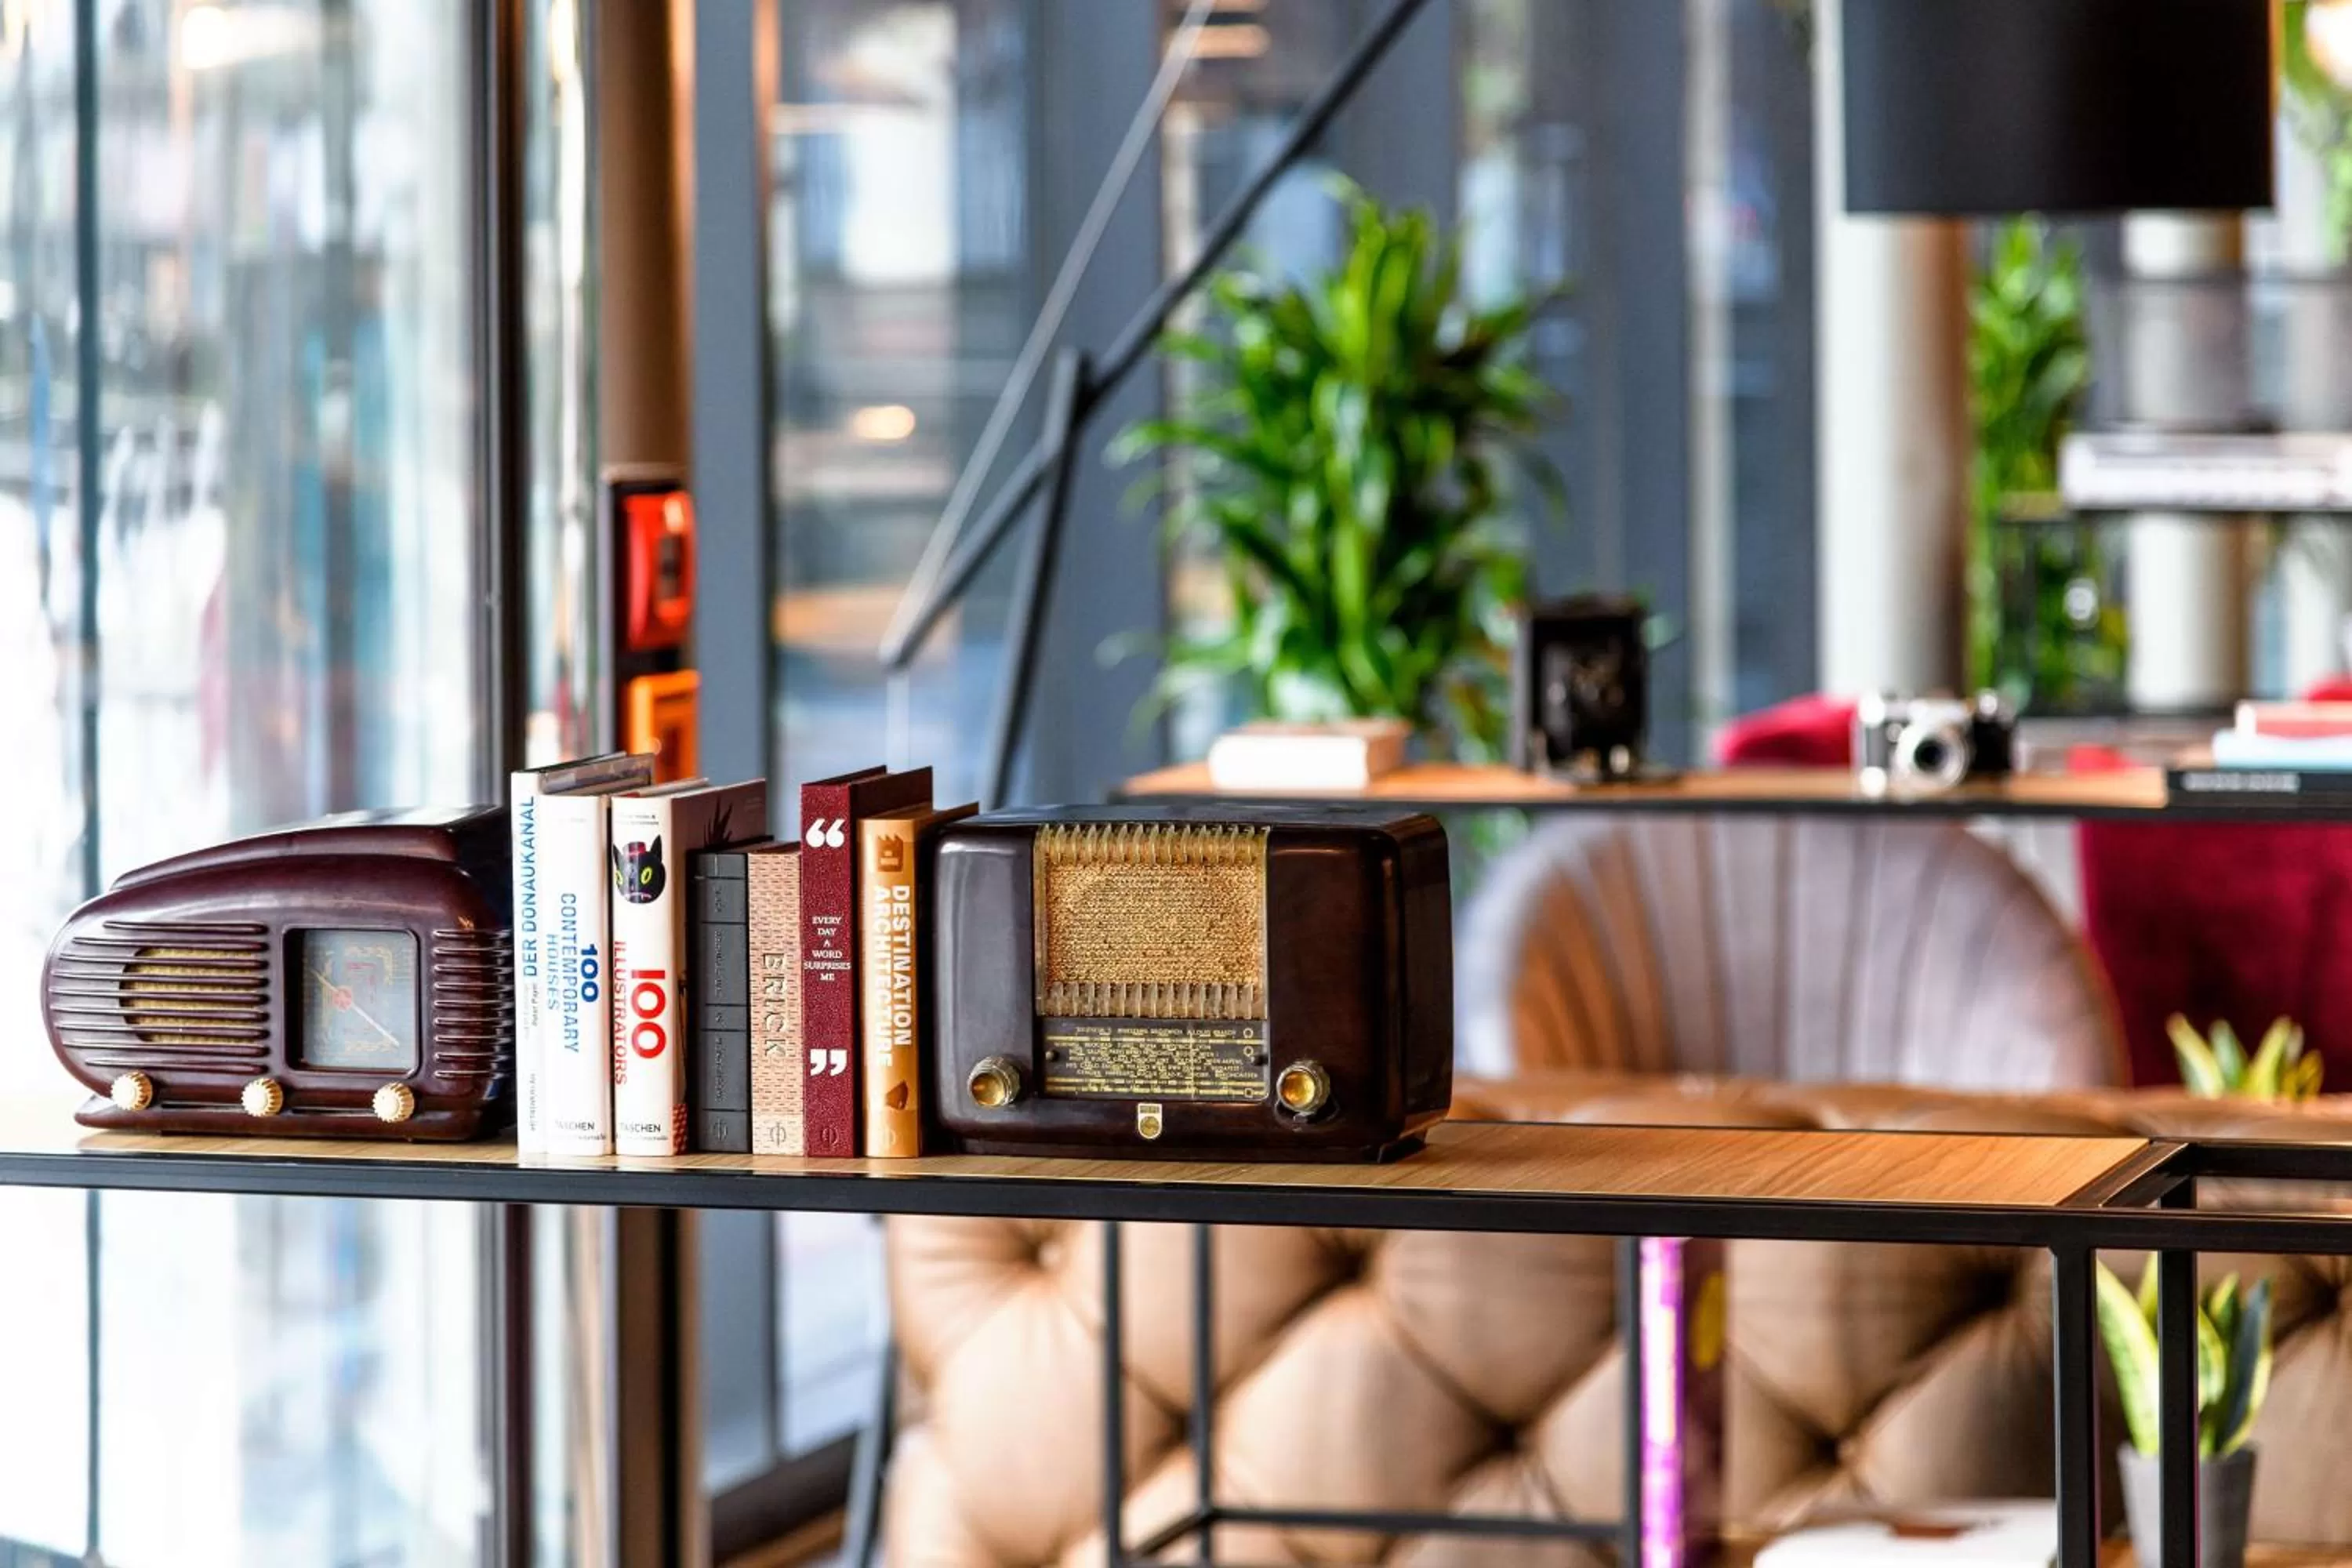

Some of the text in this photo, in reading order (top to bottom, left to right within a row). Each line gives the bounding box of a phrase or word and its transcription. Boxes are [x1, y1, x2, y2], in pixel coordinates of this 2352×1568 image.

[520, 797, 537, 977] DER DONAUKANAL
[546, 934, 561, 1011] HOUSES
[561, 893, 579, 1053] CONTEMPORARY
[581, 944, 599, 1003] 100
[804, 961, 851, 970] SURPRISES
[811, 949, 843, 958] WORD
[873, 885, 892, 1067] ARCHITECTURE
[892, 885, 912, 1046] DESTINATION
[614, 941, 628, 1086] ILLUSTRATORS
[630, 969, 666, 1059] 100
[763, 953, 788, 1058] BRICK
[554, 1120, 595, 1131] TASCHEN
[618, 1123, 661, 1133] TASCHEN
